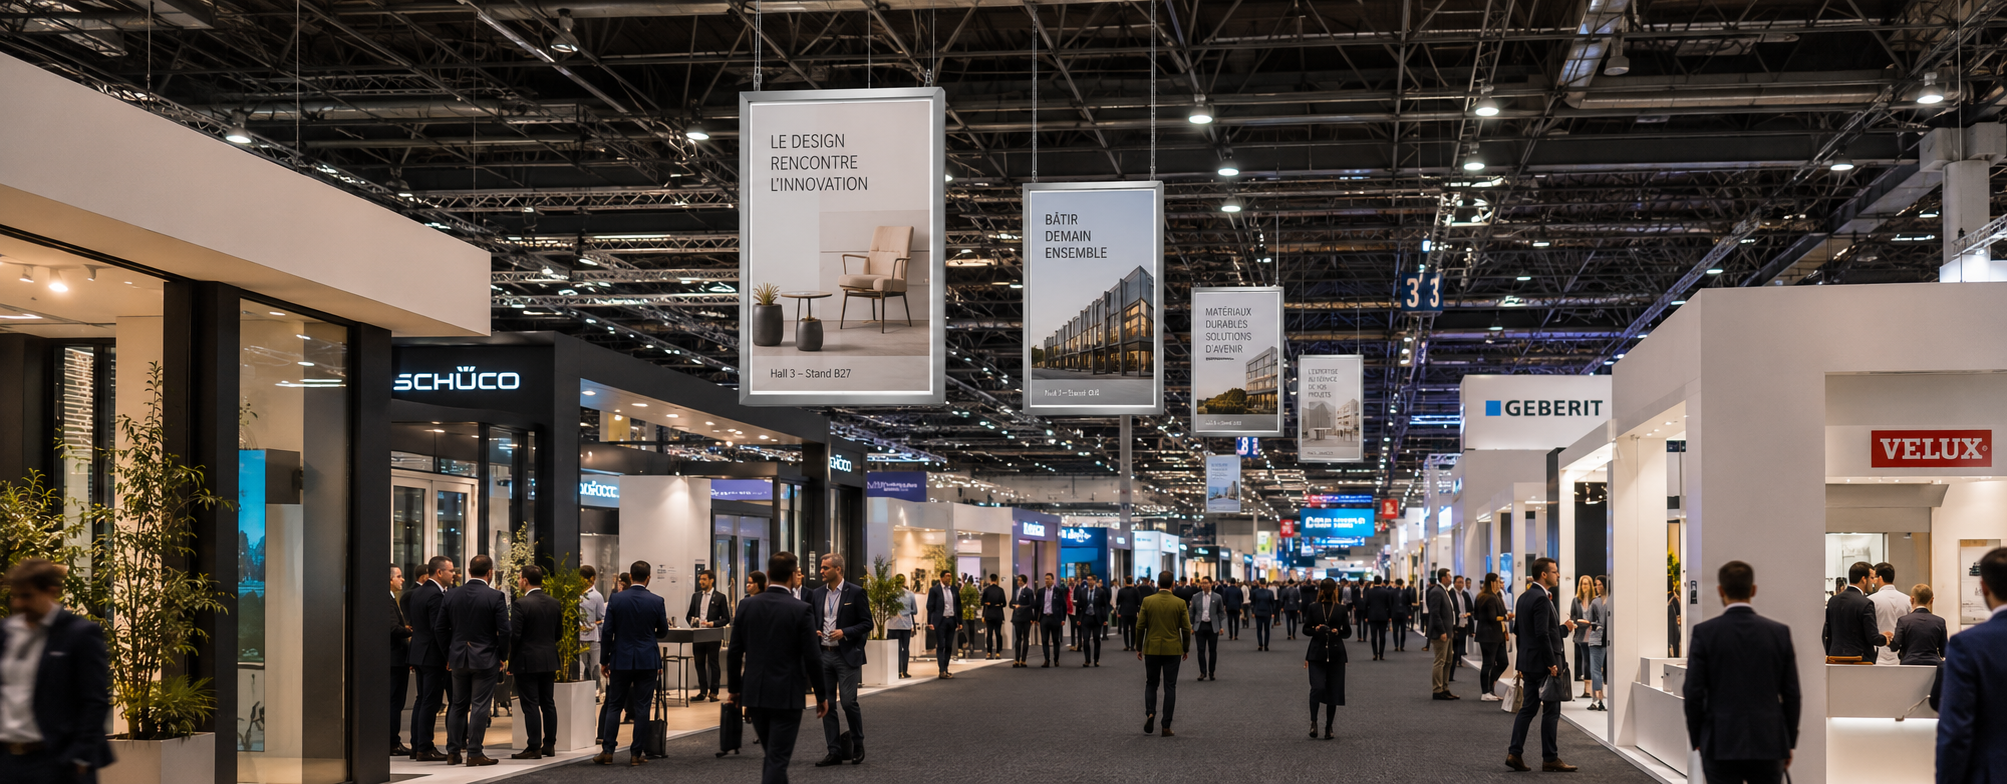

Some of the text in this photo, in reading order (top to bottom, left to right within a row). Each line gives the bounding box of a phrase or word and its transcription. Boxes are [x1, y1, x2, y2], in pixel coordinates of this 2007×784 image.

[771, 133, 845, 149] LE DESIGN
[771, 155, 858, 170] RENCONTRE
[1045, 230, 1091, 242] DEMAIN
[1045, 246, 1107, 259] ENSEMBLE
[1406, 277, 1420, 308] 3
[1429, 277, 1440, 308] 3
[1205, 305, 1252, 316] MATÉRIAUX
[1205, 319, 1248, 329] DURABLES
[1205, 332, 1252, 341] SOLUTIONS
[393, 366, 520, 391] SCHÜCO
[770, 368, 788, 379] Hall
[789, 368, 796, 379] 3
[805, 368, 832, 379] Stand
[834, 368, 851, 379] B27
[1505, 400, 1603, 416] GEBERIT
[1880, 438, 1983, 459] VELUX
